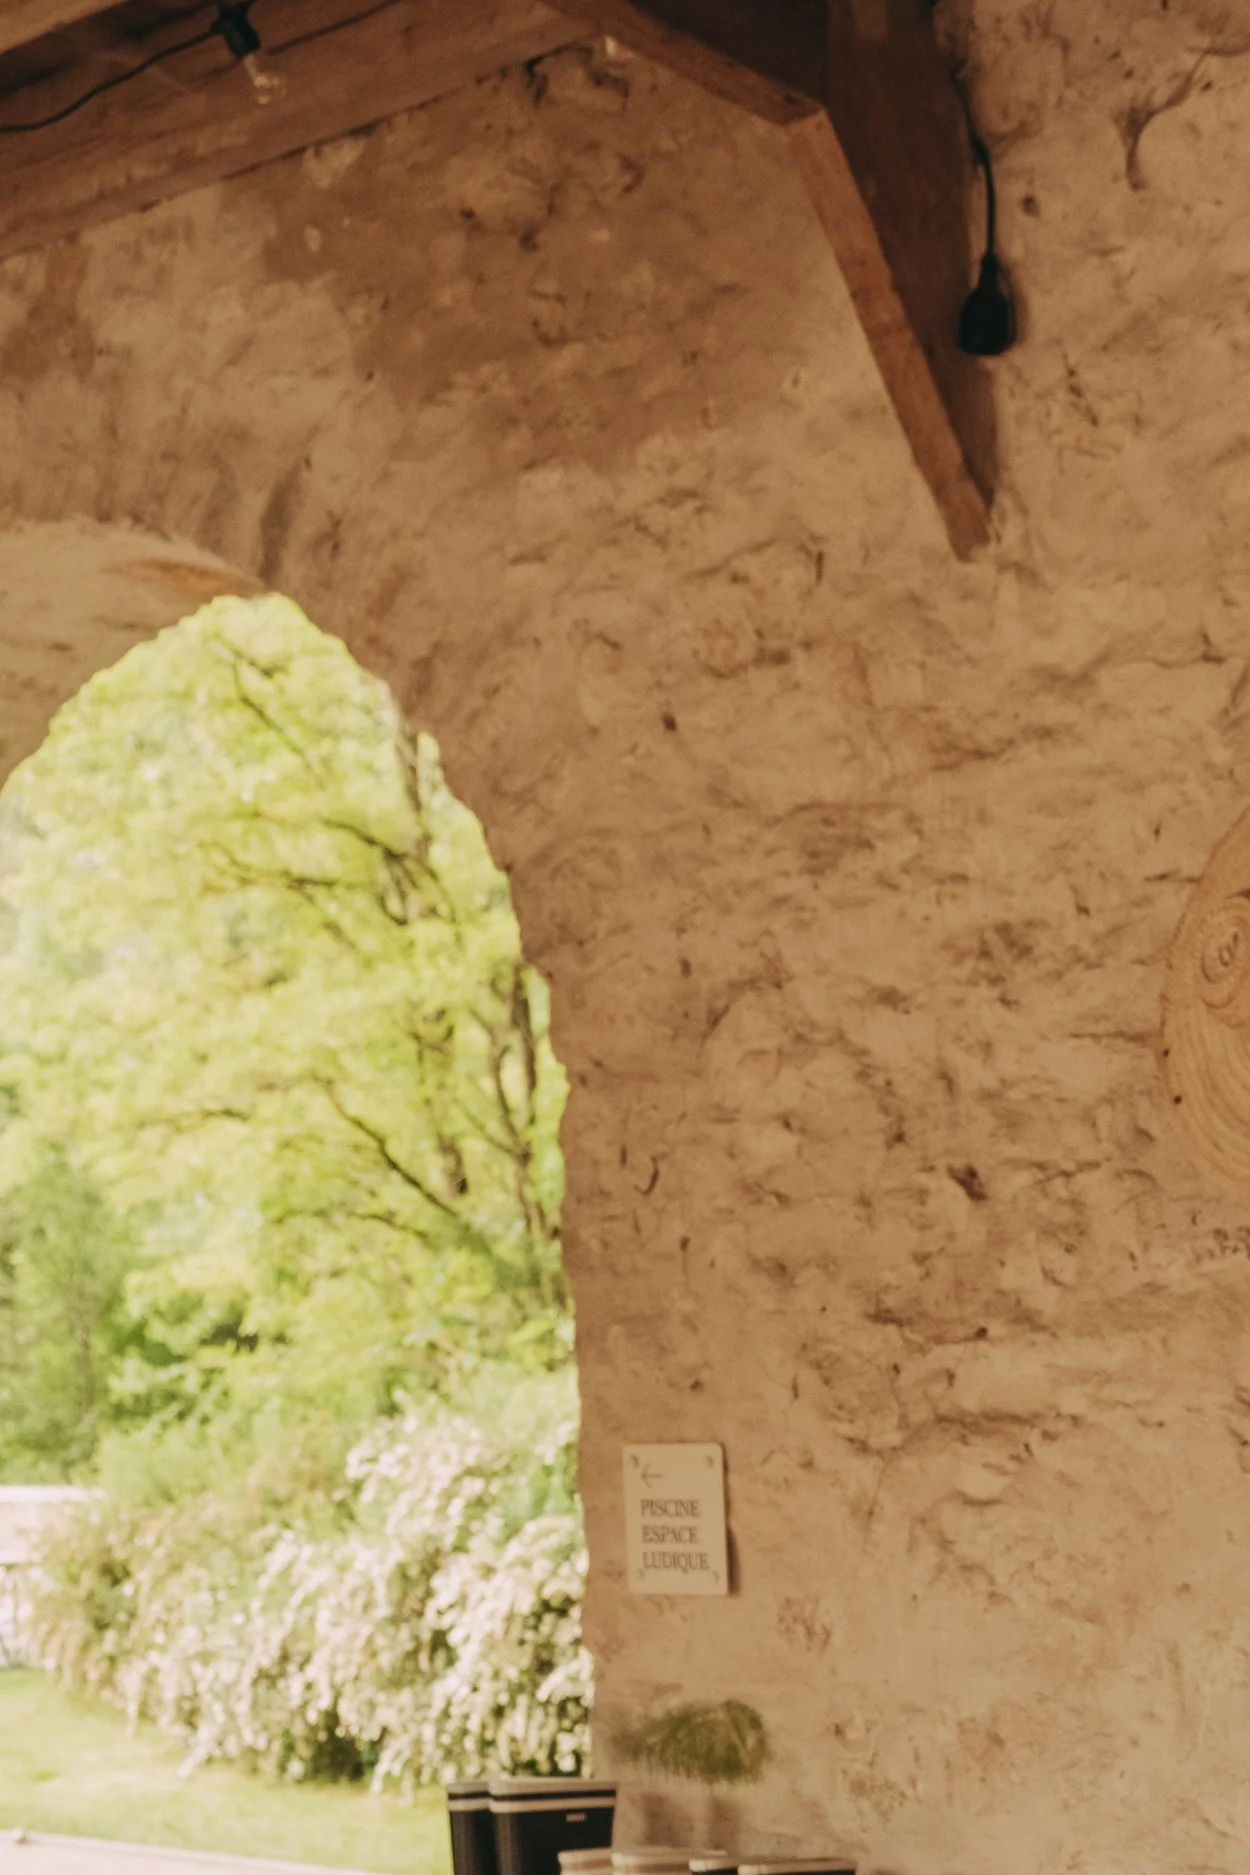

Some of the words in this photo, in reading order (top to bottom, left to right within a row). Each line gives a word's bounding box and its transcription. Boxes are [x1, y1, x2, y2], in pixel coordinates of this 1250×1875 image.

[640, 1499, 700, 1517] PISCINE
[642, 1526, 698, 1544] ESPACE
[643, 1552, 709, 1574] LUDIQUE
